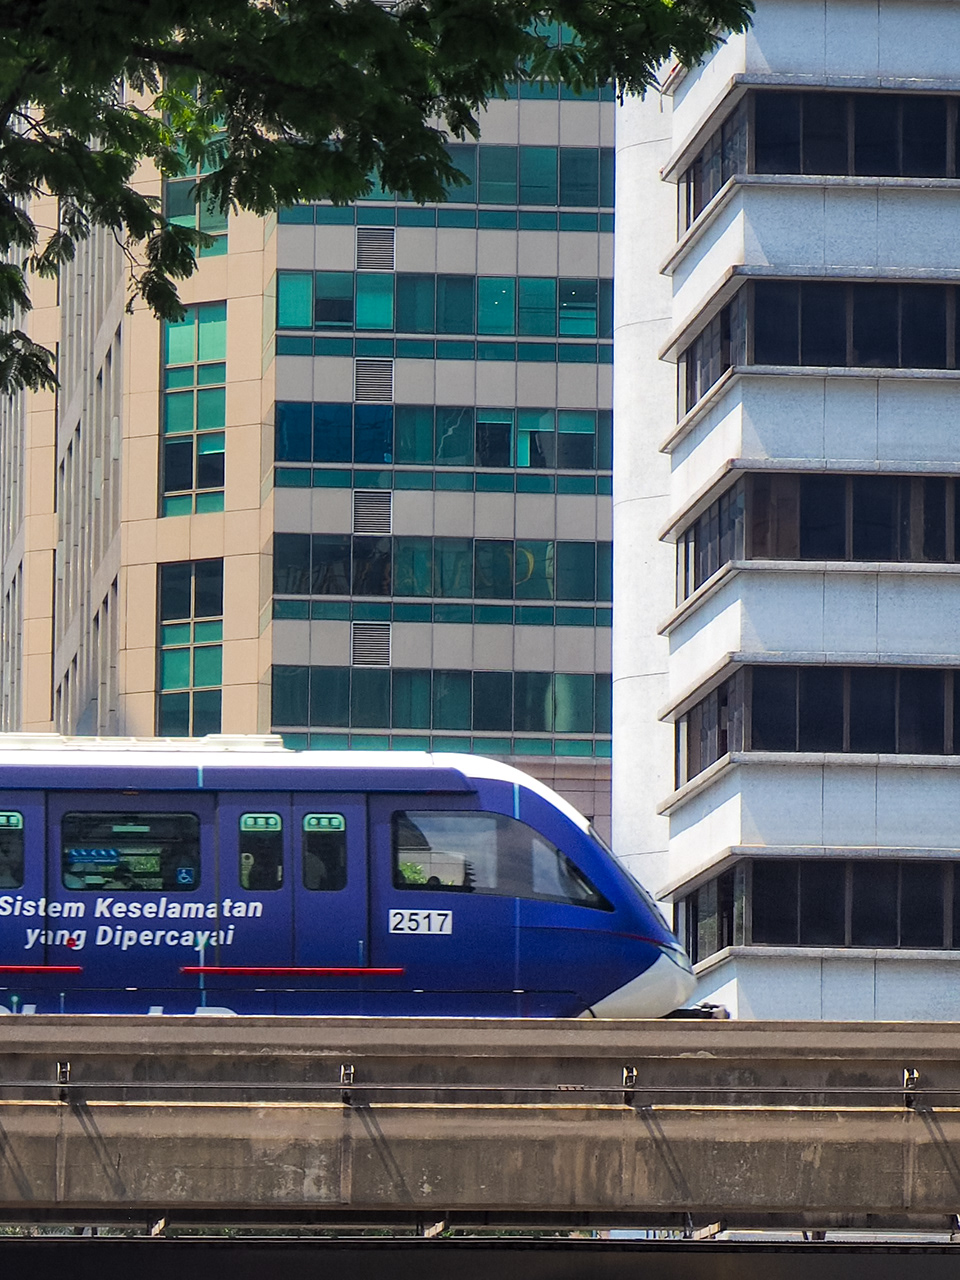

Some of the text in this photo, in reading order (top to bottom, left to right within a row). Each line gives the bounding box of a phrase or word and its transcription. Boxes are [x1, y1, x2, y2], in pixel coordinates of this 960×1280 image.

[94, 896, 263, 919] Keselamatan
[392, 912, 449, 932] 2517
[24, 925, 235, 951] yang Dipercayai
